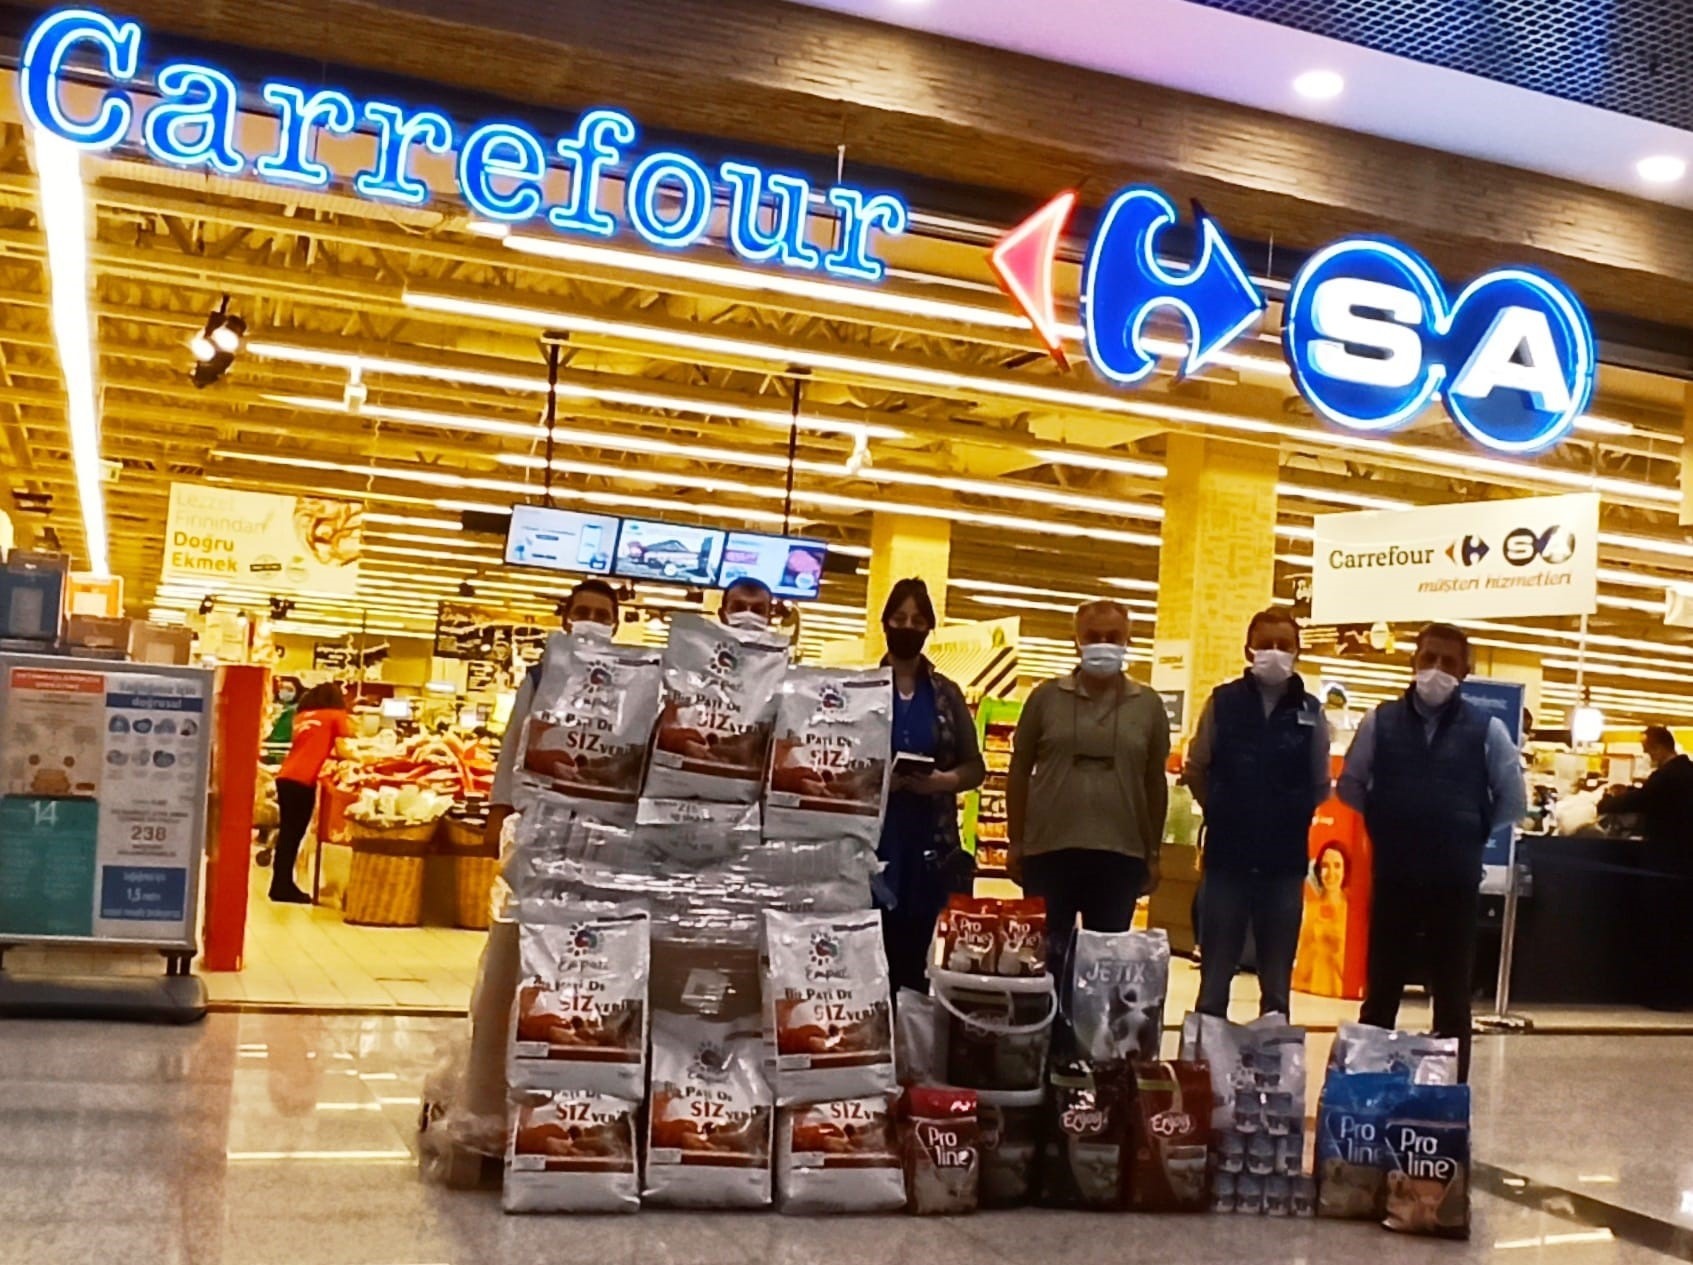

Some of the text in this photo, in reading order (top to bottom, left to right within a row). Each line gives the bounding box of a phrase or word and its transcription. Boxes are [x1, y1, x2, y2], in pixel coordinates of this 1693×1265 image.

[20, 8, 1580, 420] Carrefour SA
[173, 530, 235, 554] Doğru
[171, 551, 238, 573] Ekmek
[1328, 545, 1435, 569] Carrefour
[28, 799, 61, 827] 14
[131, 825, 167, 841] 238
[1085, 961, 1146, 983] JETIX
[928, 1126, 958, 1148] Pro
[1340, 1114, 1376, 1142] Pro
[1400, 1127, 1439, 1156] Pro
[936, 1145, 969, 1168] line
[1407, 1150, 1450, 1180] line
